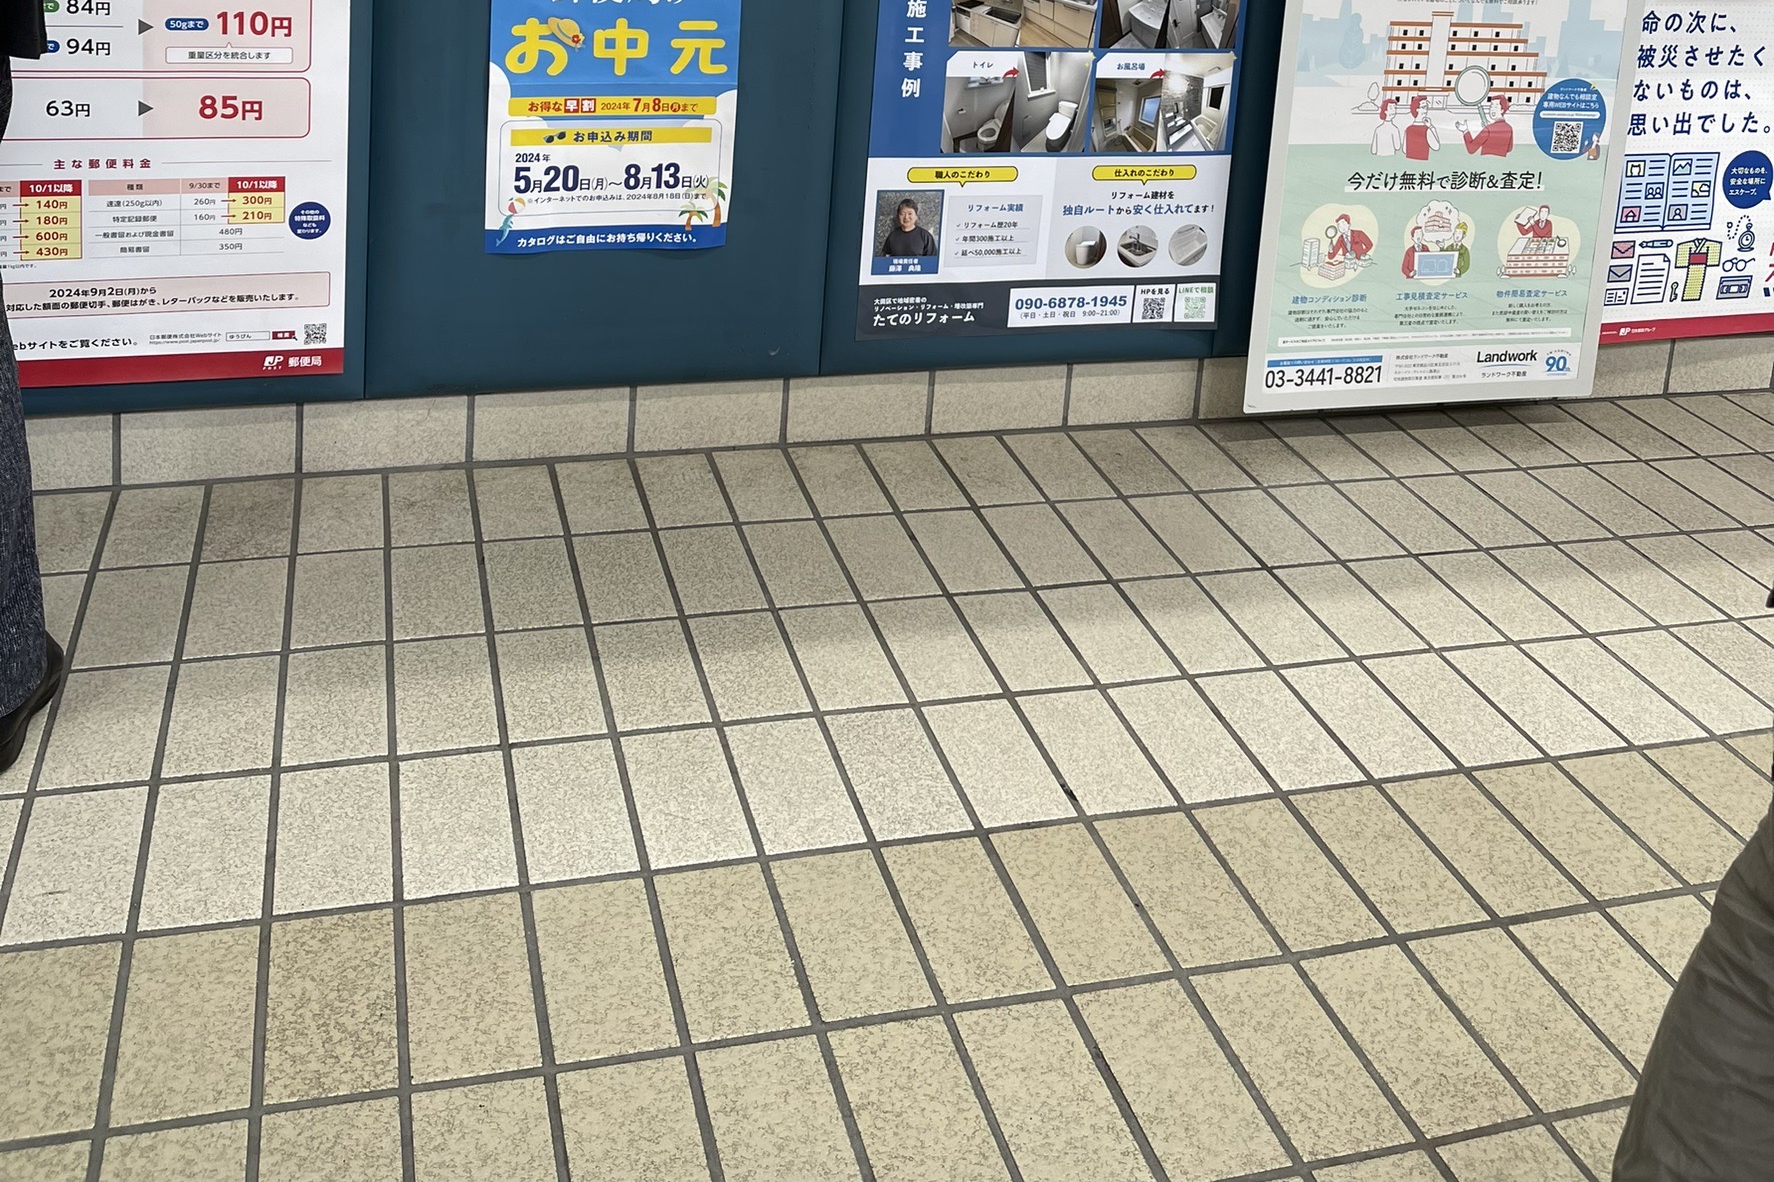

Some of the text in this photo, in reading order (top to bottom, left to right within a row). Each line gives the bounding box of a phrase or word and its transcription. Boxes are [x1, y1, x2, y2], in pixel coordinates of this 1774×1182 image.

[169, 18, 205, 31] 50gまで
[216, 11, 294, 38] 110円
[1641, 10, 1738, 34] 命の次に、
[66, 38, 272, 61] 94円 重量区分を統合します
[505, 17, 729, 77] お中元
[1637, 44, 1767, 69] 被災させたく
[972, 60, 993, 68] トイレ
[1116, 61, 1146, 71] お風呂場
[1547, 92, 1598, 101] 建物なんでも相談室
[1633, 78, 1752, 102] ないものは、
[45, 95, 264, 122] 63円 85円
[527, 97, 597, 113] お得な早割
[1627, 111, 1771, 136] 思い出でした。
[573, 130, 653, 143] お申込み期間
[53, 158, 152, 170] 主な郵便料金
[515, 152, 551, 163] 2024年
[934, 168, 1175, 180] 職人のこだわり 仕入れのこだわり
[1730, 166, 1768, 175] 大切なものを、
[29, 179, 278, 194] 10/1以降 種類 9/30まで 10/1以降
[1347, 170, 1543, 192] 今だけ無料で診断&査定!
[1729, 177, 1766, 186] 安全な場所に
[1111, 190, 1175, 201] リフォーム建材を
[1728, 188, 1758, 196] エスケープ。
[36, 194, 273, 210] 140円 速達(250g以内) 260円 300円
[967, 203, 1024, 213] リフォーム実績
[1062, 203, 1215, 217] 独自ルートから安く仕入れてます!
[36, 210, 273, 226] 180円 特定記録郵便 160円 210円
[963, 221, 1019, 229] リフォーム歴20年
[35, 227, 243, 241] 600円 一般書留および現金書留 480円
[517, 232, 697, 249] カタログはご自由にお持ち帰りください。
[962, 234, 1015, 242] 年間300施工以上
[35, 242, 243, 256] 430円 簡易書留 350円
[960, 248, 1022, 256] 延べ50,000施工以上
[49, 285, 157, 299] 2024年9月2日(月)から
[1140, 287, 1170, 296] HPを見る
[1291, 289, 1568, 305] 建物コンディション診断 工事見積査定サービス 物件簡易査定サービス
[6, 292, 299, 313] 対応した額面の郵便切手、郵便はがき、レターパックなどを販売いたします。
[1014, 295, 1128, 311] 090-6878-1945
[873, 311, 975, 327] たてのリフォーム
[149, 332, 222, 340] 日本郵便株式会社Webサイト
[288, 355, 322, 367] 郵便局
[1476, 349, 1538, 364] Landwork
[1545, 355, 1570, 372] 90
[1264, 364, 1382, 389] 03-3441-8821
[1481, 370, 1528, 379] ランドワーク不動産
